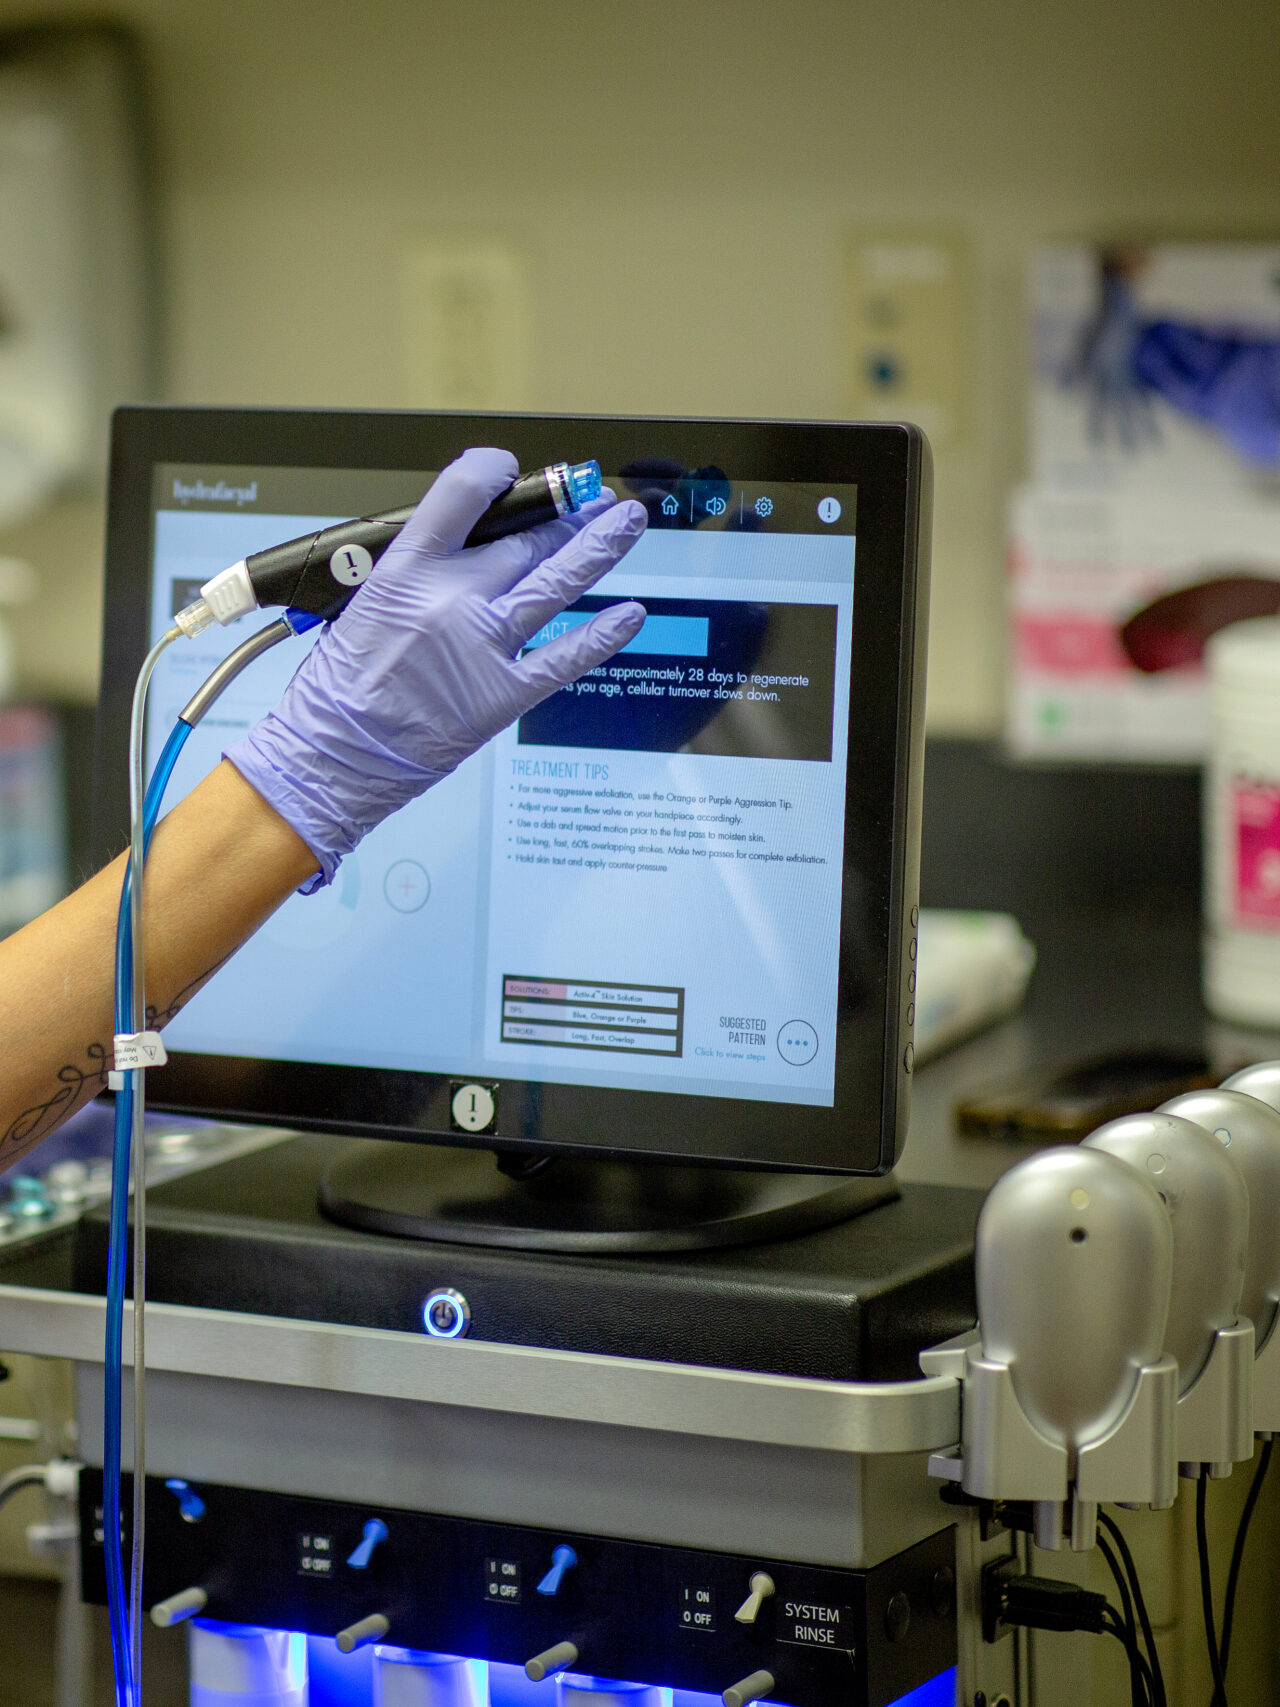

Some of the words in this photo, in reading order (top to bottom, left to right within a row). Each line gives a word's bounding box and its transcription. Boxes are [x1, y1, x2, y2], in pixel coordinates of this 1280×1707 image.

[538, 622, 569, 640] ACT
[609, 666, 685, 685] approximately
[688, 668, 704, 682] 28
[707, 669, 734, 686] days
[737, 671, 747, 683] to
[751, 673, 809, 689] regenerate
[576, 683, 596, 696] you
[599, 683, 624, 698] age,
[627, 681, 665, 696] cellular
[668, 683, 711, 698] turnover
[713, 685, 744, 699] slows
[746, 688, 781, 702] down.
[511, 759, 581, 779] TREATMENT
[584, 763, 609, 780] TIPS
[518, 784, 530, 793] For
[532, 786, 551, 794] more
[553, 787, 593, 798] aggressive
[594, 788, 635, 800] exfoliation,
[638, 792, 651, 800] use
[652, 792, 664, 801] the
[666, 793, 696, 804] Orange
[698, 796, 707, 804] or
[708, 795, 732, 806] Purple
[734, 797, 776, 809] Aggression
[779, 799, 793, 811] Tip.
[517, 801, 541, 813] Adjust
[542, 804, 558, 814] your
[560, 805, 582, 814] serum
[584, 804, 600, 815] flow
[602, 806, 622, 816] valve
[624, 809, 634, 817] on
[636, 809, 652, 819] your
[654, 808, 694, 821] handpiece
[696, 811, 743, 825] accordingly.
[516, 818, 531, 828] Use
[540, 819, 556, 829] dab
[558, 821, 573, 831] and
[575, 822, 601, 833] spread
[603, 824, 629, 834] motion
[630, 827, 648, 836] prior
[650, 827, 658, 836] to
[660, 827, 671, 837] the
[673, 828, 687, 838] first
[688, 831, 706, 841] pass
[708, 831, 716, 839] to
[718, 832, 746, 842] moisten
[748, 832, 766, 843] skin.
[516, 836, 531, 845] Use
[571, 839, 589, 849] 60%
[591, 841, 636, 854] overlapping
[667, 846, 690, 856] Make
[691, 847, 707, 856] two
[708, 849, 734, 859] passes
[736, 849, 747, 859] for
[748, 851, 784, 863] complete
[786, 853, 828, 865] exfoliation.
[515, 853, 534, 863] Hold
[536, 854, 550, 864] skin
[552, 856, 566, 865] taut
[567, 856, 583, 867] and
[584, 857, 606, 869] apply
[590, 1012, 615, 1022] Orange
[626, 1015, 647, 1025] Purple
[719, 1016, 767, 1031] SUGGESTED
[608, 1035, 635, 1045] Overlap
[728, 1031, 766, 1046] PATTERN
[694, 1046, 714, 1057] Click
[716, 1049, 724, 1058] to
[725, 1050, 744, 1059] view
[746, 1052, 766, 1063] steps
[501, 1562, 516, 1576] ON
[500, 1584, 518, 1597] OFF
[696, 1590, 710, 1603] ON
[694, 1612, 712, 1625] OFF
[785, 1602, 840, 1623] SYSTEM
[795, 1625, 835, 1644] RINSE
